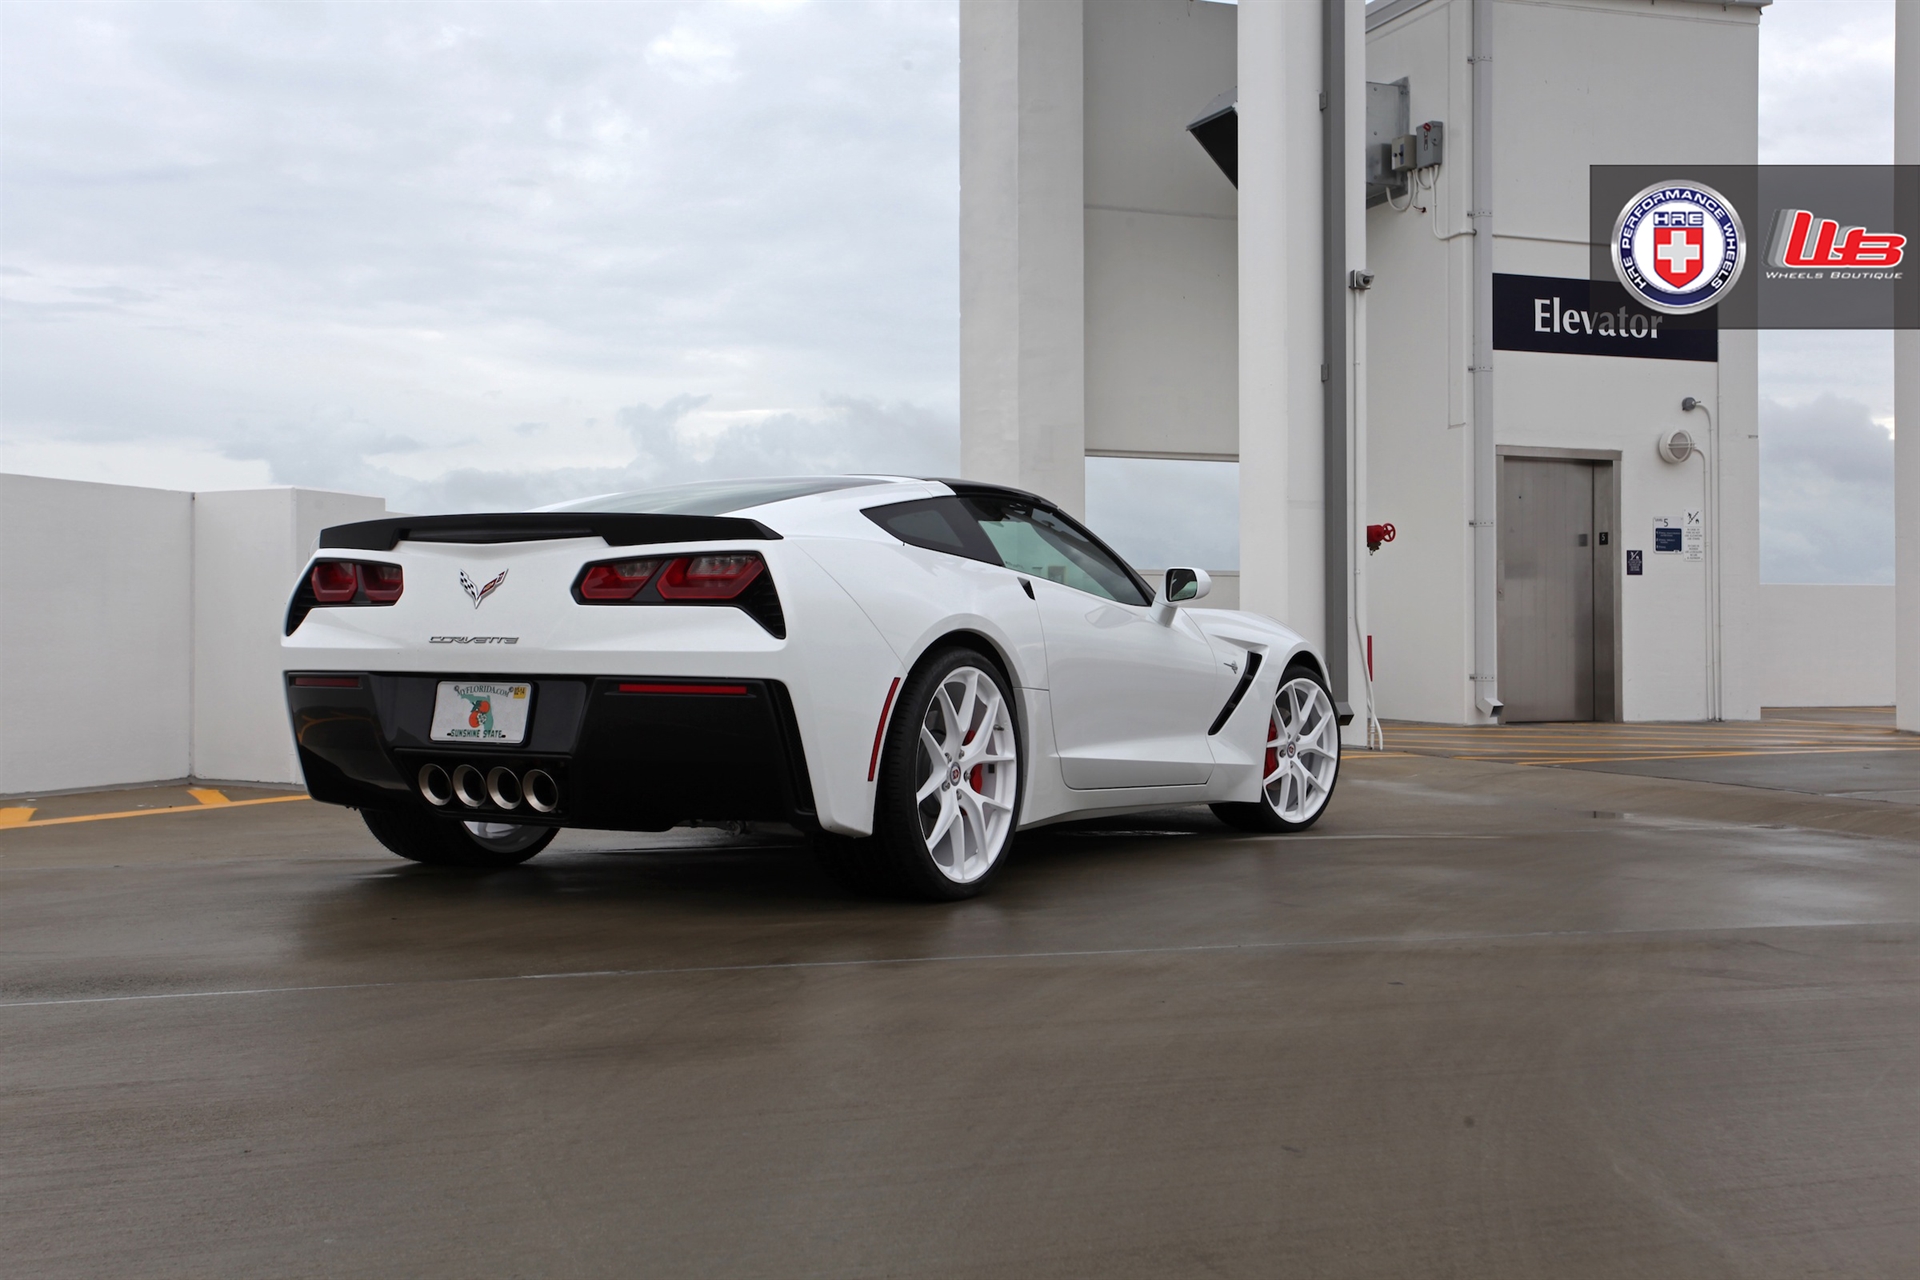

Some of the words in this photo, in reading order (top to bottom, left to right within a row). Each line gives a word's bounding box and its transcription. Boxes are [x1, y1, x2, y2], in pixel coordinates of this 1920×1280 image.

[1533, 296, 1663, 339] Elevator
[1664, 518, 1669, 527] 5
[1601, 533, 1606, 541] 5
[429, 636, 519, 644] CORVETTE
[450, 729, 481, 738] SUNSHINE
[483, 730, 502, 739] STATE
